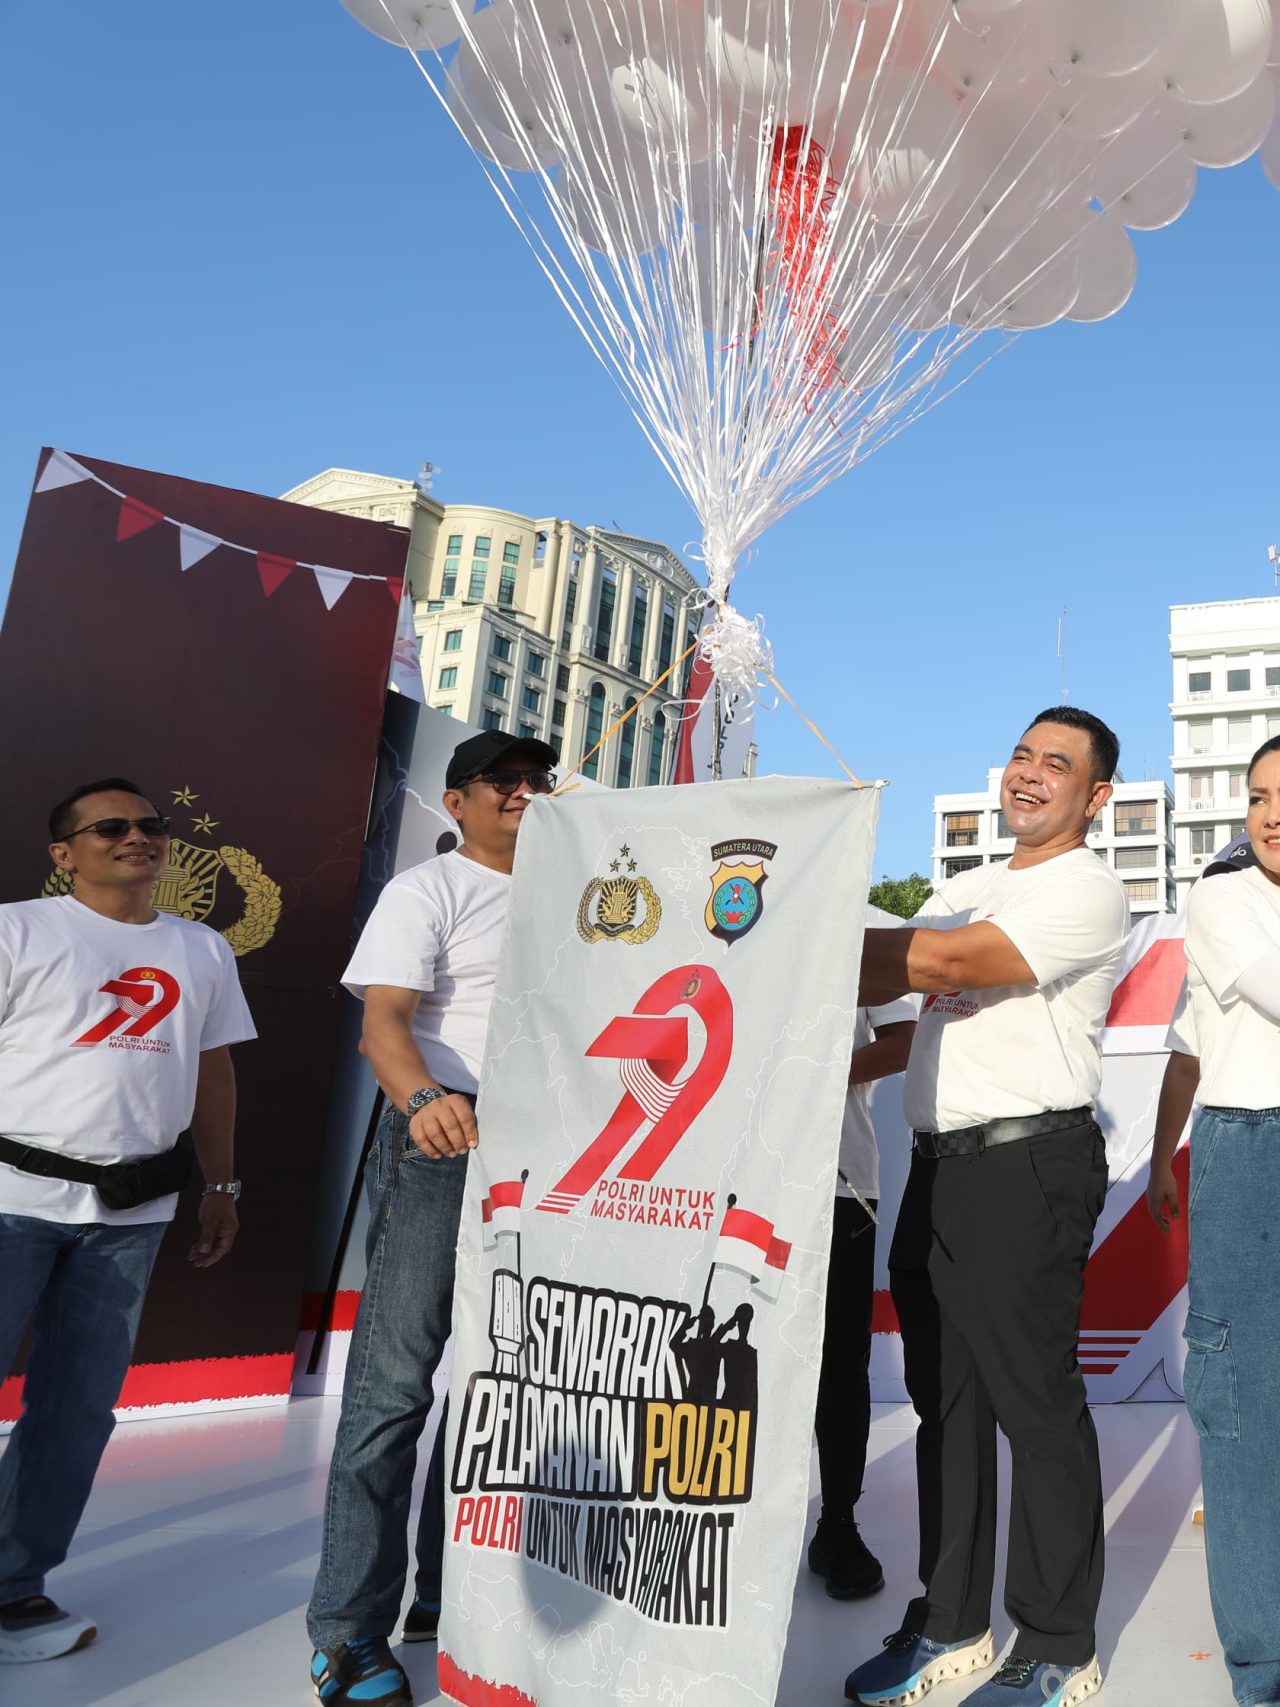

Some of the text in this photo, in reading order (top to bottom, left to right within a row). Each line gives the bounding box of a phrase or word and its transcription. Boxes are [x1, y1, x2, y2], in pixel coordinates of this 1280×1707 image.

[713, 842, 774, 858] SUMATERA UTARA
[954, 999, 979, 1010] UNTUK
[108, 1042, 171, 1054] MASYARAKAT
[109, 1035, 172, 1048] POLRI UNTUK
[597, 1180, 716, 1210] POLRI UNTUK
[590, 1198, 714, 1231] MASYARAKAT
[528, 1283, 687, 1400] SEMARAK
[456, 1378, 751, 1497] PELAYANAN POLRI
[453, 1496, 735, 1628] POLRI UNTUK MASYARAKAT
